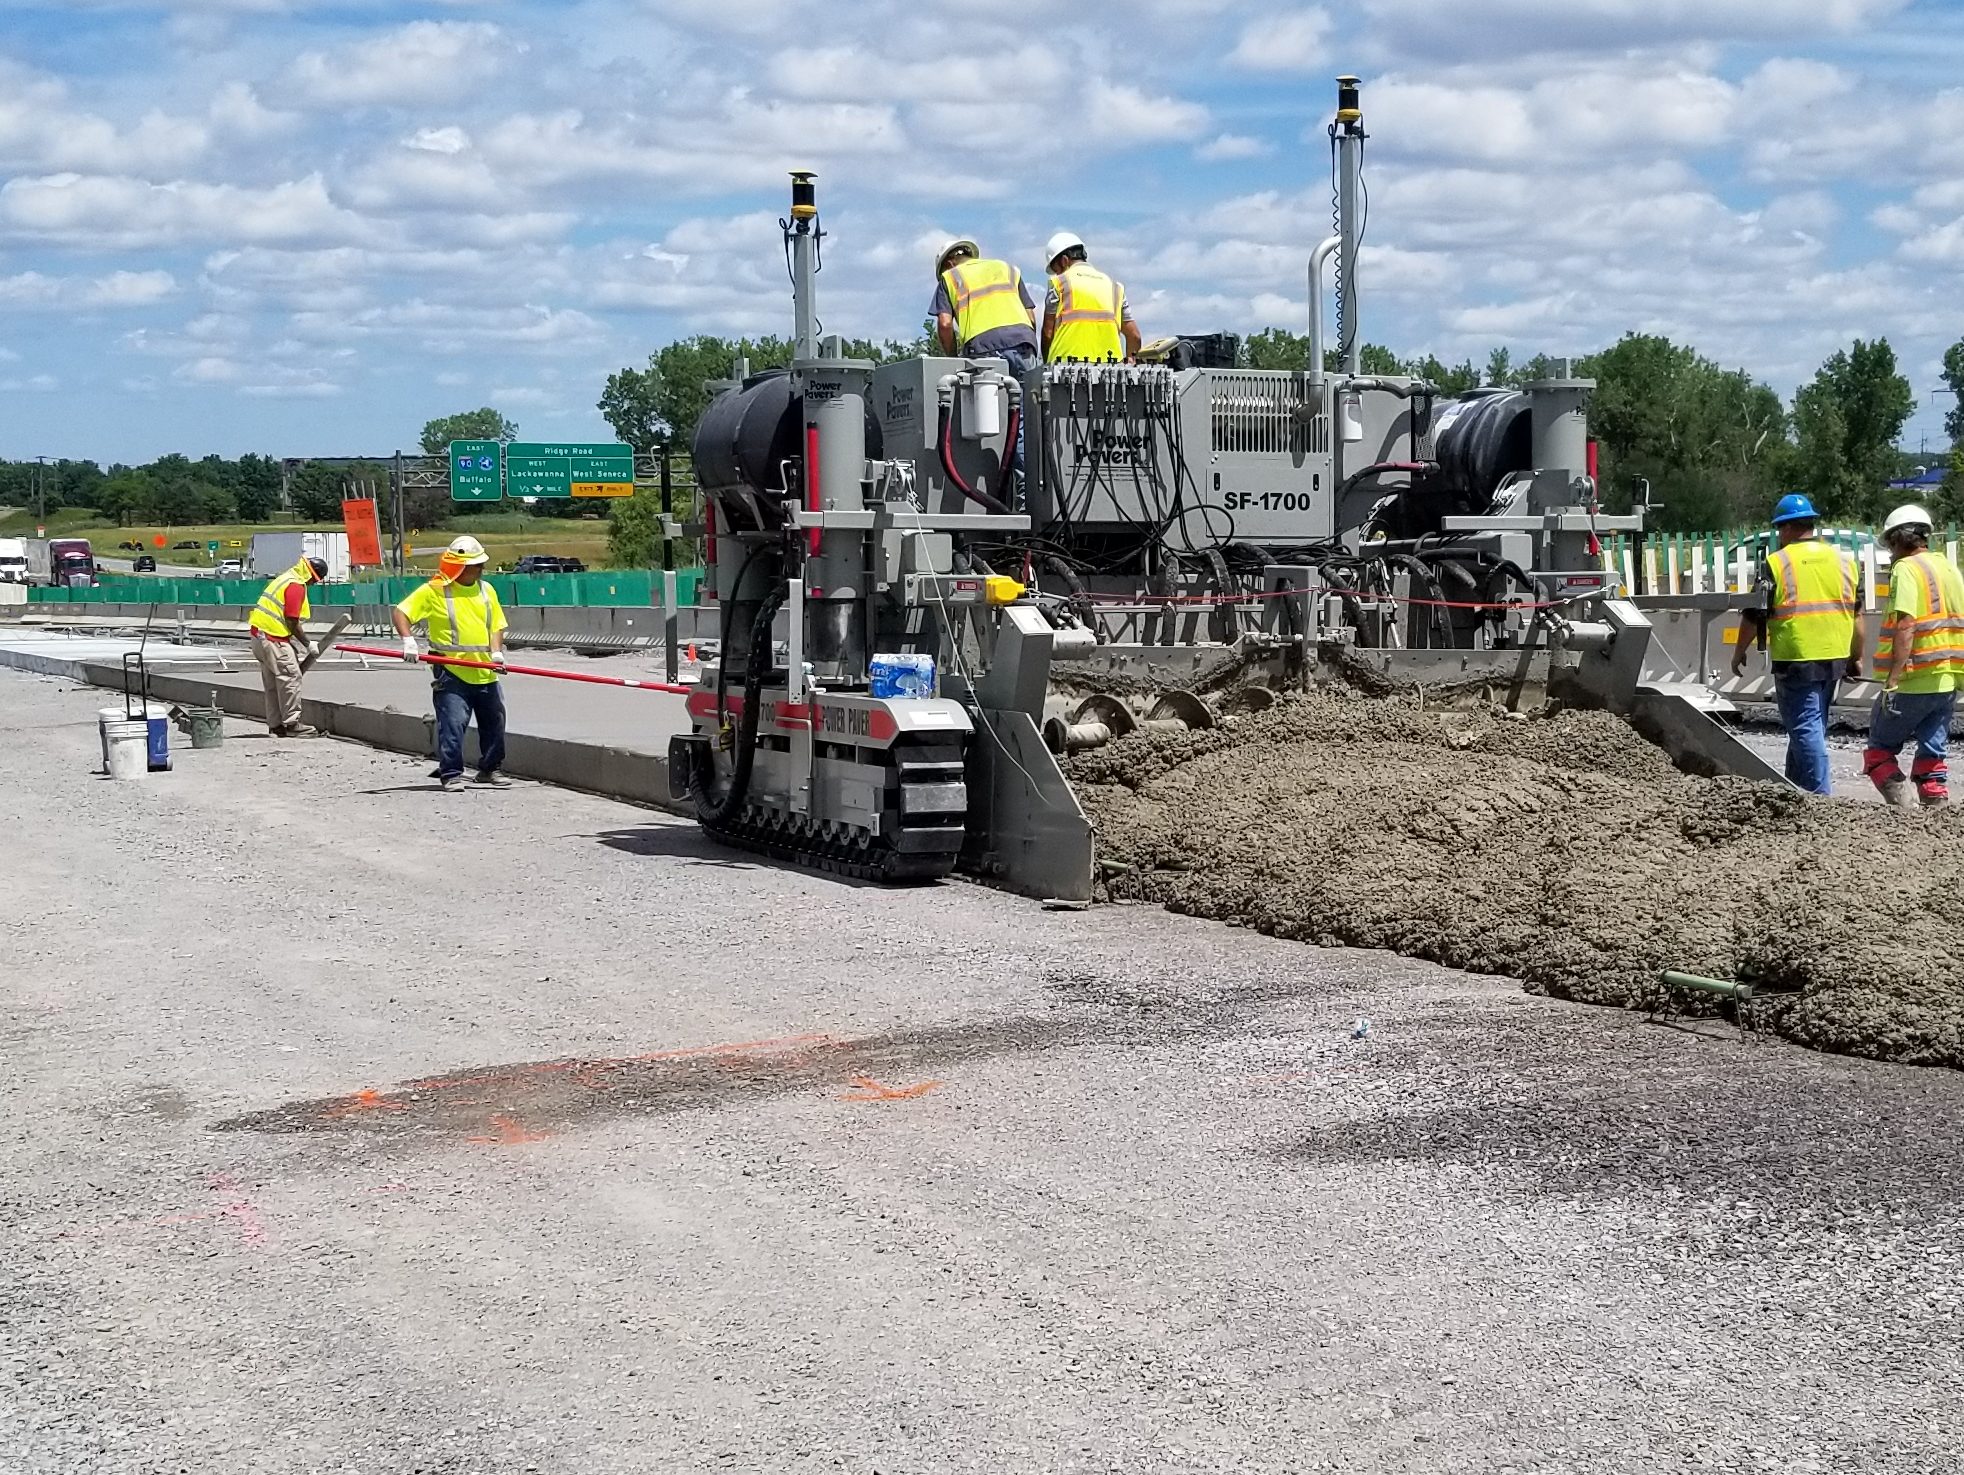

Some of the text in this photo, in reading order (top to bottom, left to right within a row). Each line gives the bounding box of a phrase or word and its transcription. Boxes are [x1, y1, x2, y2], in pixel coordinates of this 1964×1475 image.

[810, 380, 842, 391] Power
[892, 384, 914, 404] Power
[1093, 429, 1152, 450] Power
[544, 447, 593, 456] Ridge Road
[1075, 444, 1139, 465] Pavers
[511, 470, 565, 478] Lackawanna
[572, 470, 627, 478] West Seneca
[1223, 491, 1311, 511] SF-1700
[822, 705, 870, 737] POWER PAVER
